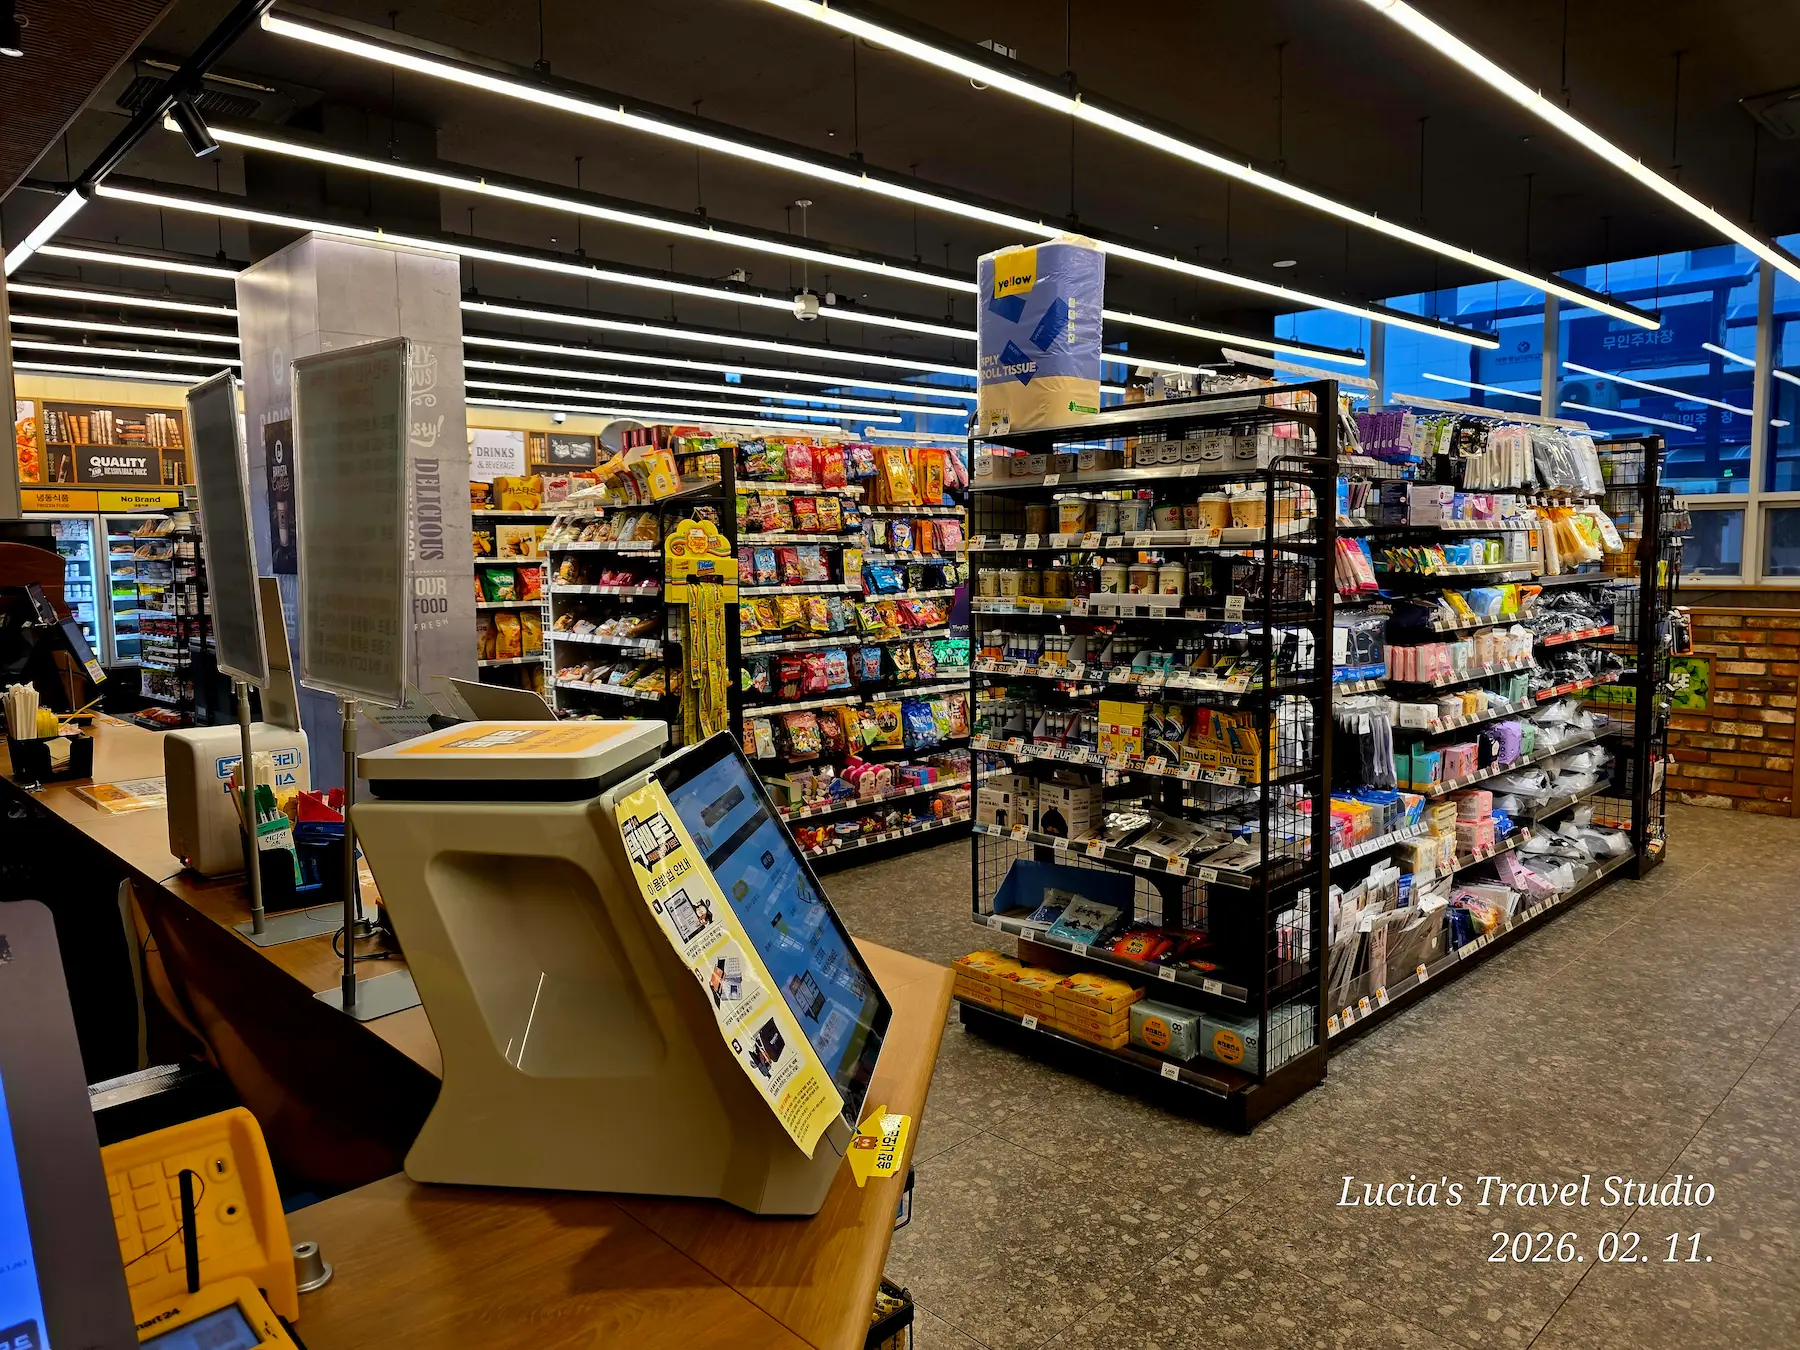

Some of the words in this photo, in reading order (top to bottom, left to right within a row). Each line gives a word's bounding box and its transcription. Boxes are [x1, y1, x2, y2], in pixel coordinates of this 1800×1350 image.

[1602, 329, 1675, 350] 무인주차장
[1002, 361, 1037, 376] TISSUE
[476, 446, 515, 458] DRINKS
[90, 456, 146, 467] QUALITY
[477, 461, 485, 469] &
[485, 461, 516, 470] BEVERAGE
[36, 494, 69, 502] 냉동식품
[508, 485, 537, 497] 카스타드
[414, 457, 445, 561] DELICIOUS
[415, 576, 448, 596] OUR
[413, 598, 448, 614] FOOD
[413, 617, 449, 632] FRESH
[673, 857, 692, 877] 안내
[876, 1153, 894, 1170] 송장
